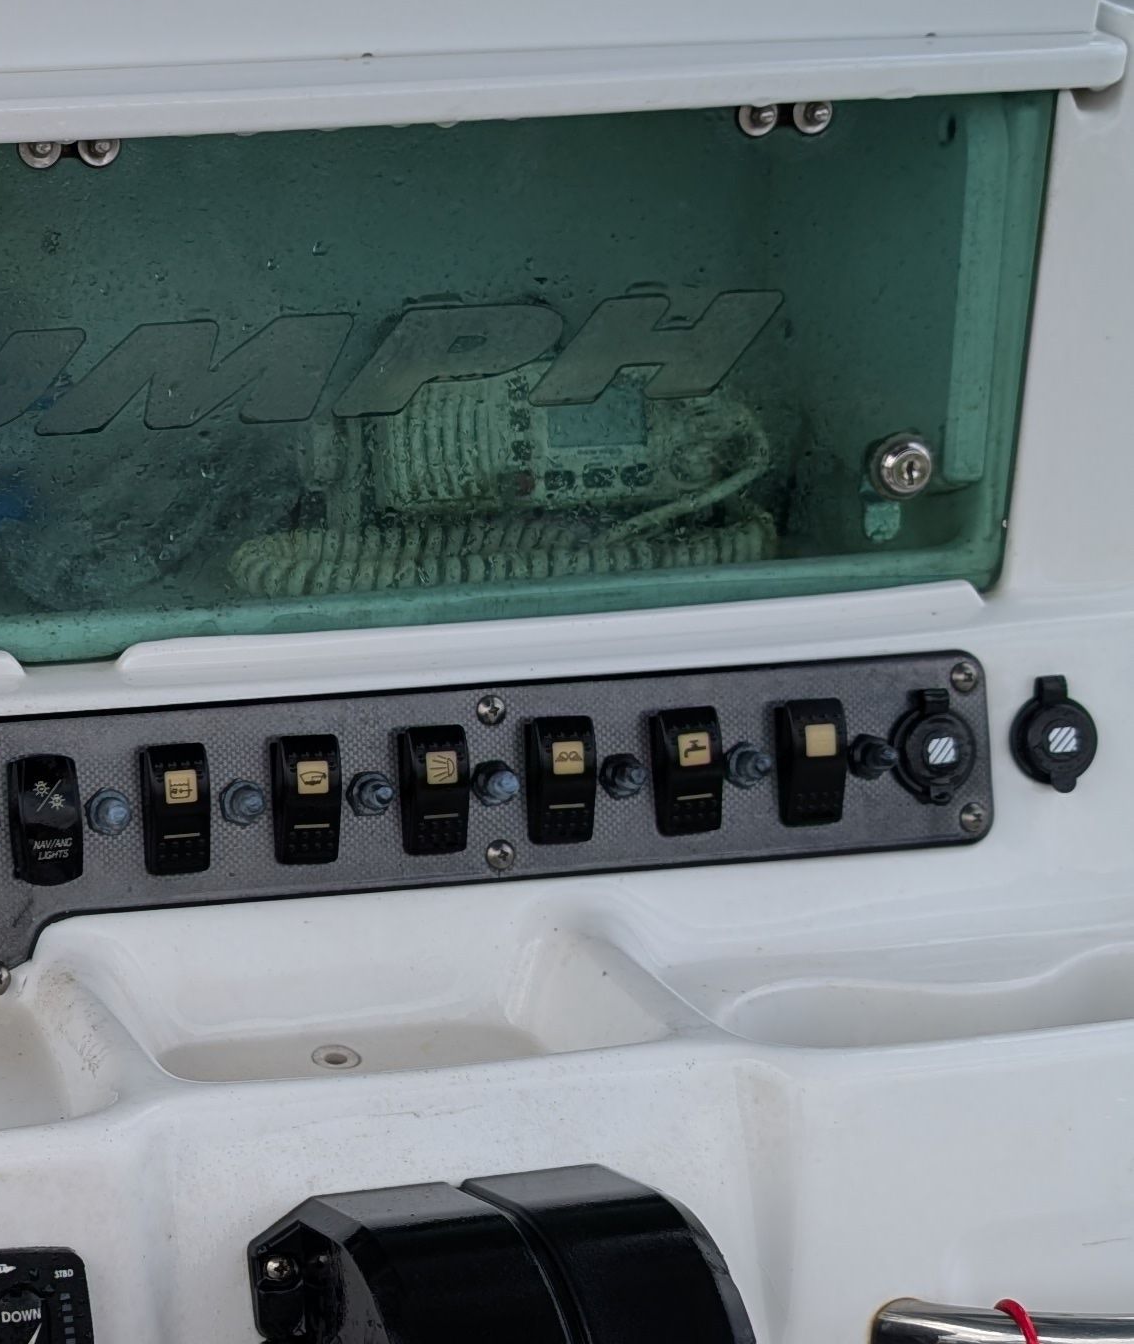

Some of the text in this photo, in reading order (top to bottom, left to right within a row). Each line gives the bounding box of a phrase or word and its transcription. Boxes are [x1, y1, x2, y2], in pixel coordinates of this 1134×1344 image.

[37, 849, 69, 861] LIGHTS
[54, 1268, 74, 1280] STBD
[1, 1308, 42, 1324] DOWN
